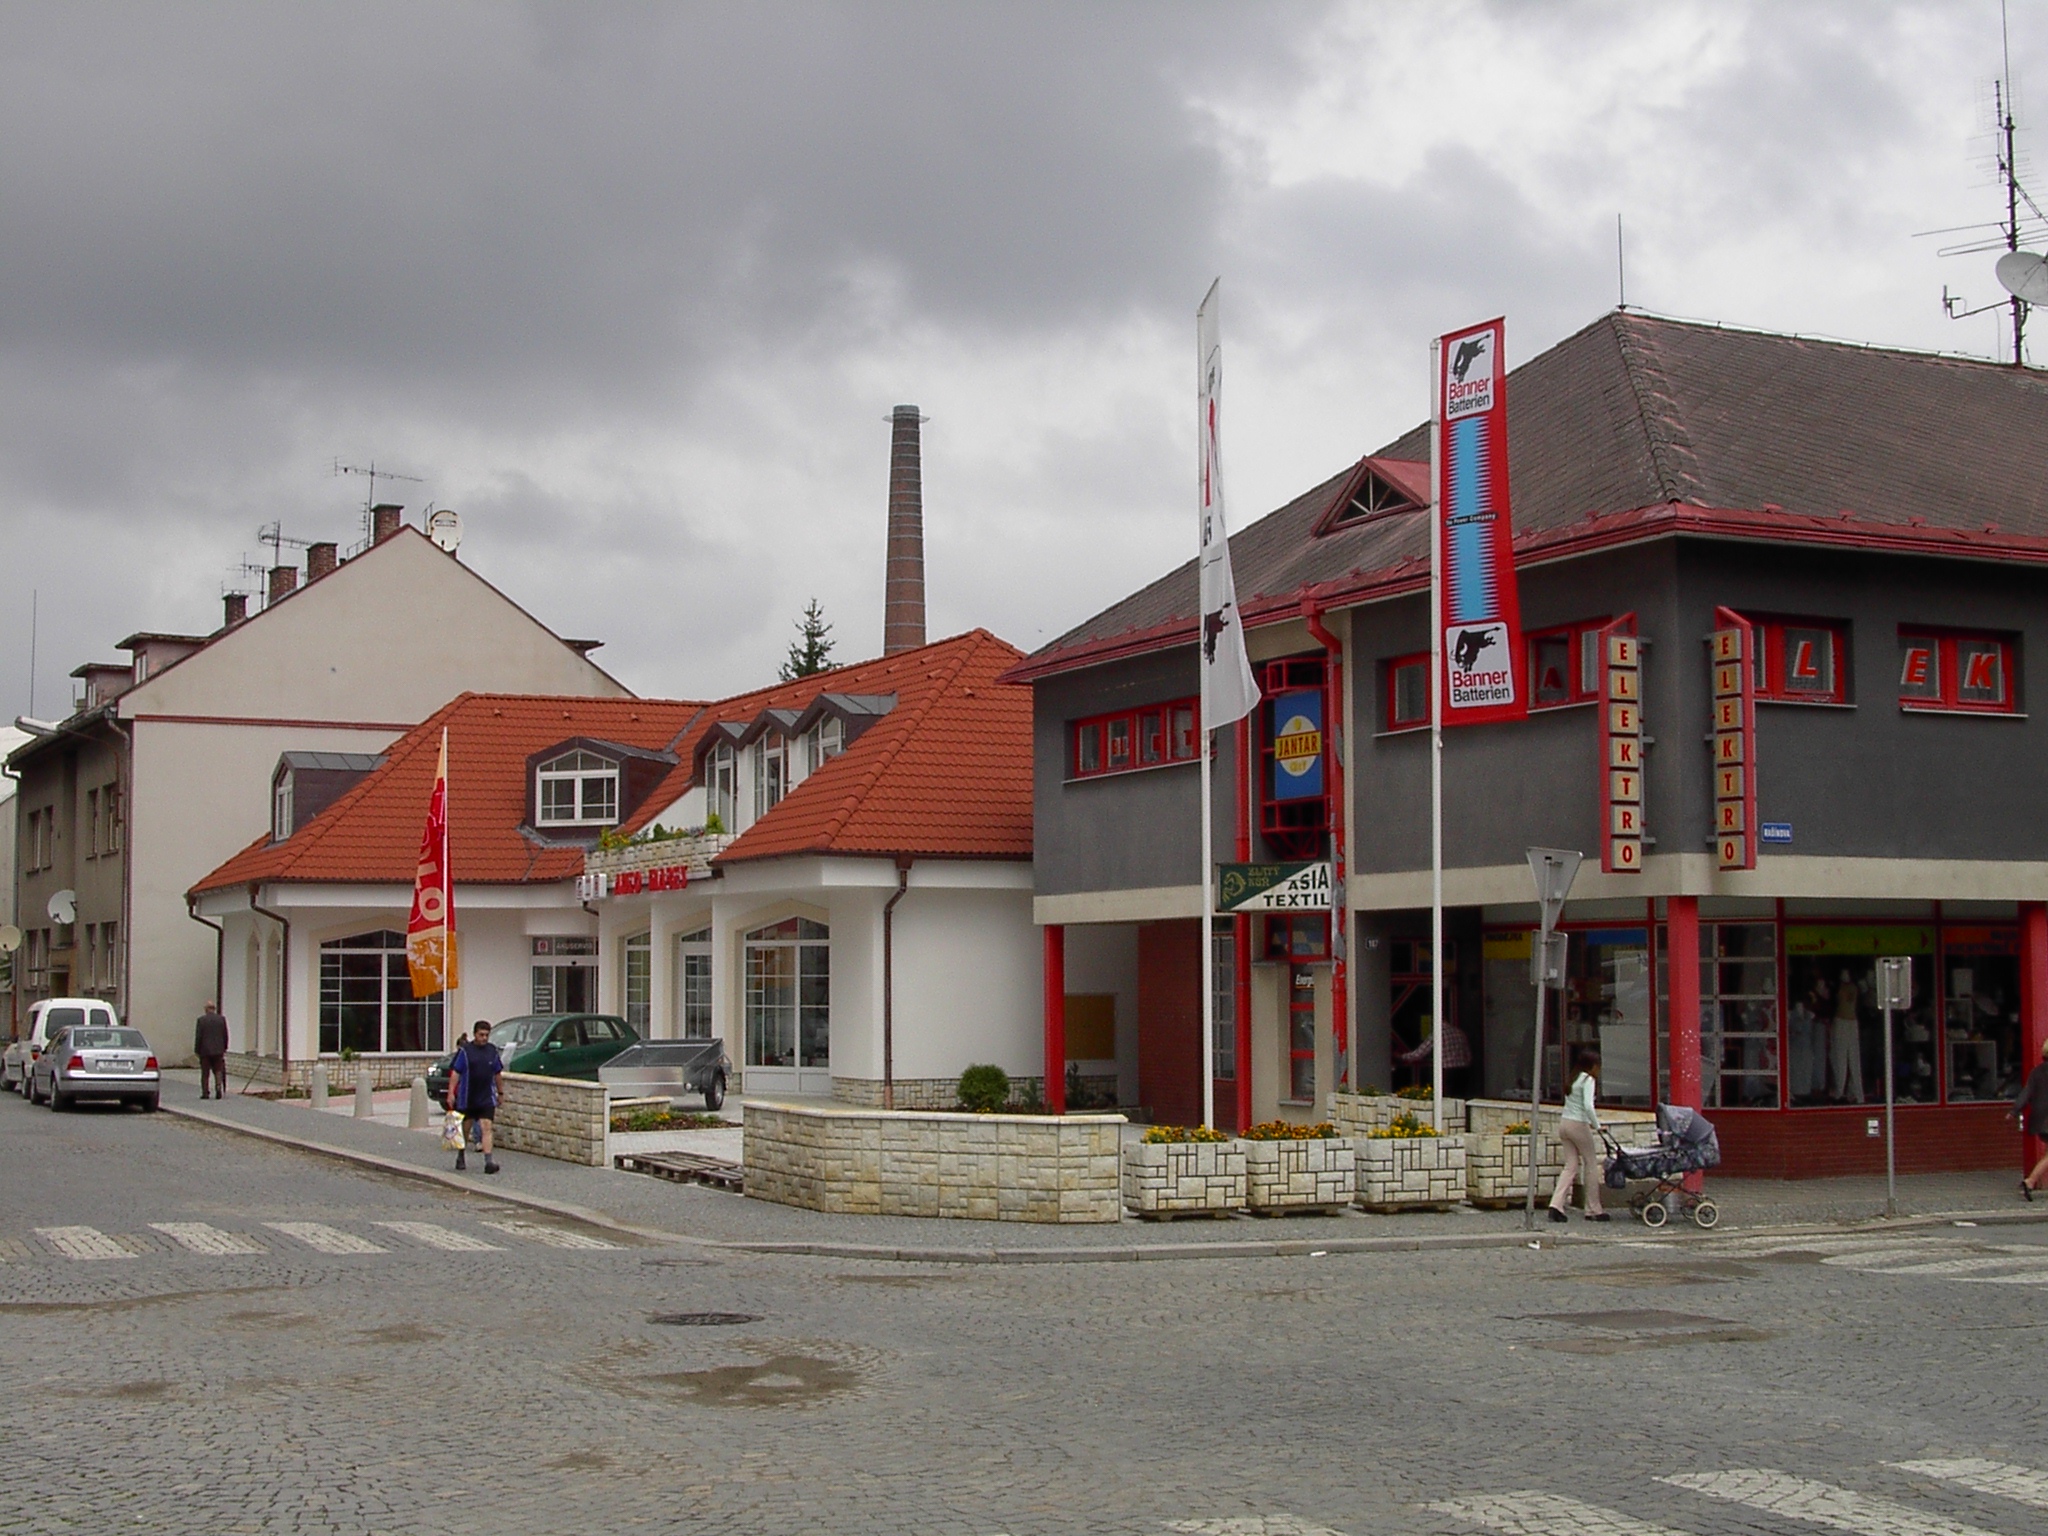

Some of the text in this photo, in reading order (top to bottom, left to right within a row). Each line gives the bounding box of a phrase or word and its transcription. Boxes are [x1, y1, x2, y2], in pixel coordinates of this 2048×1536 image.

[1449, 377, 1490, 400] Banner
[1448, 394, 1490, 415] Batterien
[1469, 513, 1497, 523] Company
[1452, 670, 1508, 688] Banner
[1452, 686, 1510, 704] Batterien
[1278, 735, 1318, 757] JANTAR
[1618, 641, 1633, 864] ELEKTRO
[1720, 635, 1735, 861] ELEKTRO
[1288, 864, 1329, 891] ASIA
[1263, 893, 1330, 907] TEXTIL
